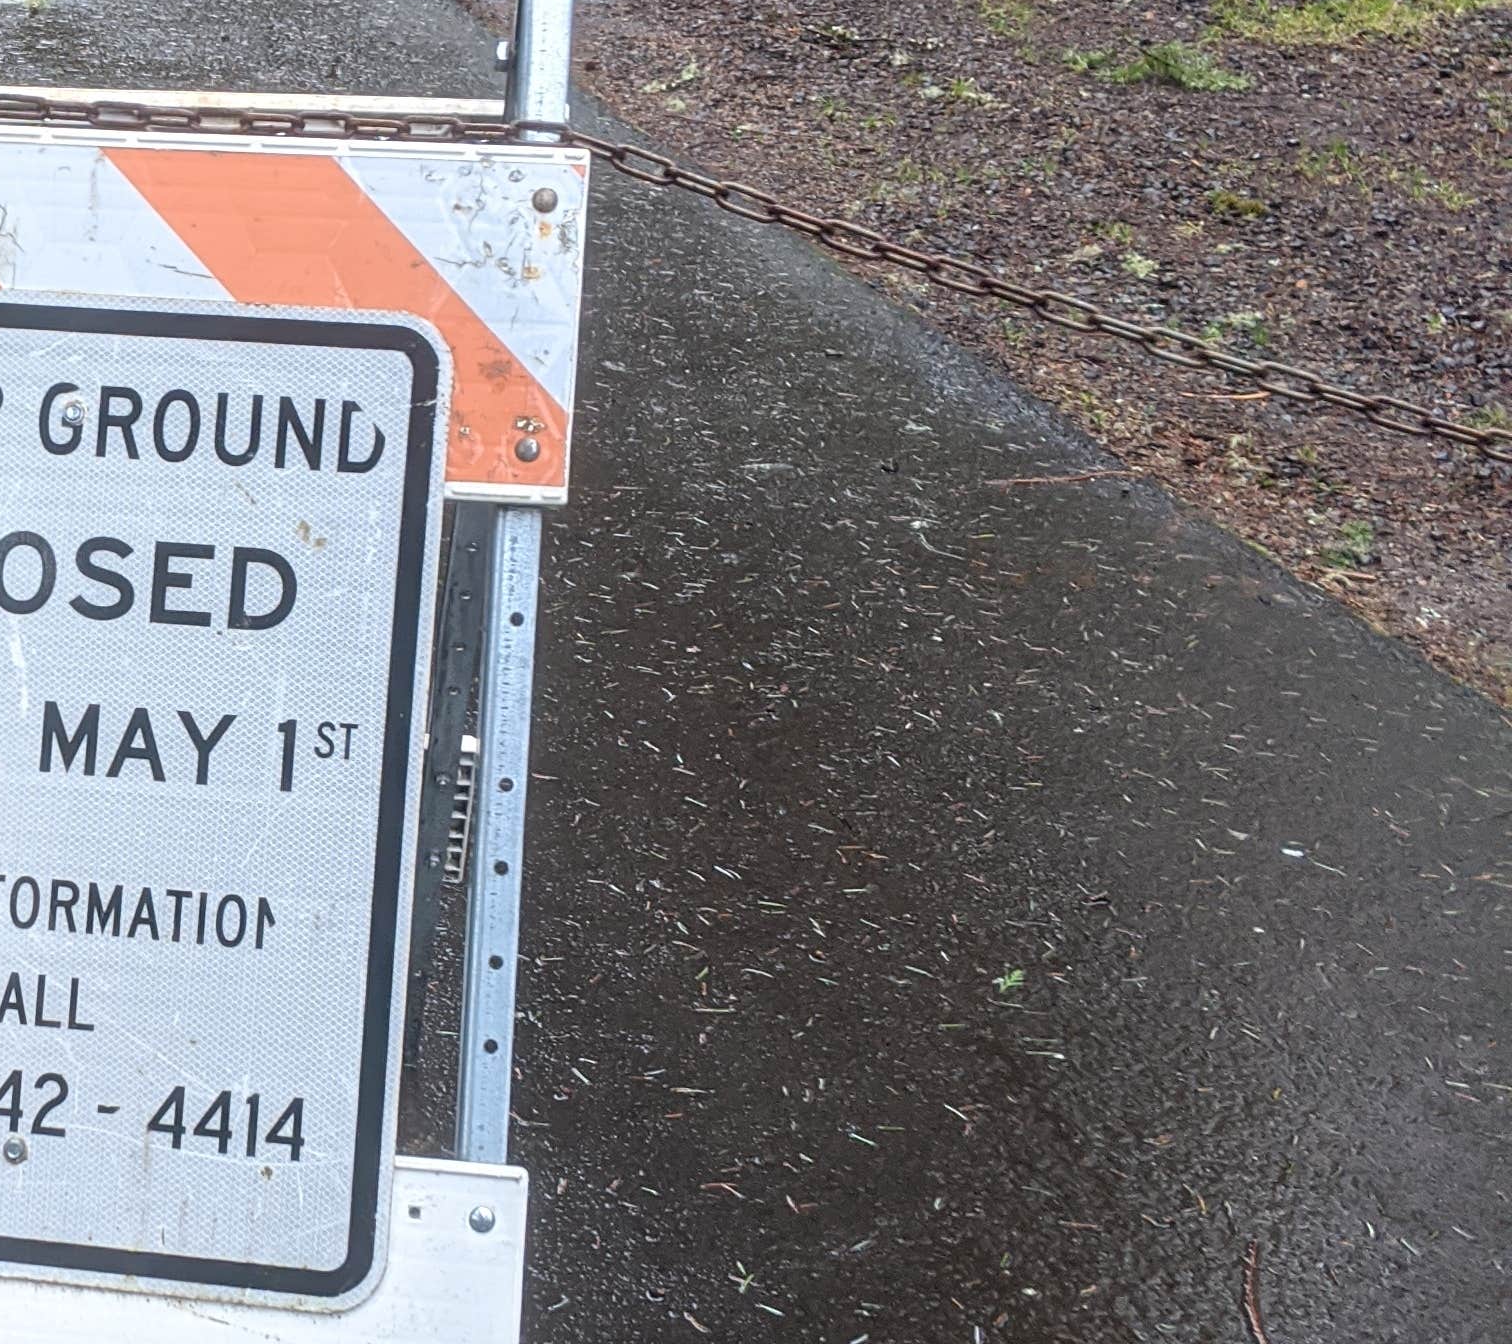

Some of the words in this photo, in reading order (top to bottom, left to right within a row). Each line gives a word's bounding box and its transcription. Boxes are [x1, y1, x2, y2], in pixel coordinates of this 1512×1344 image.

[38, 382, 386, 474] GROUND
[39, 701, 237, 786] MAY
[147, 1085, 306, 1163] 4414
